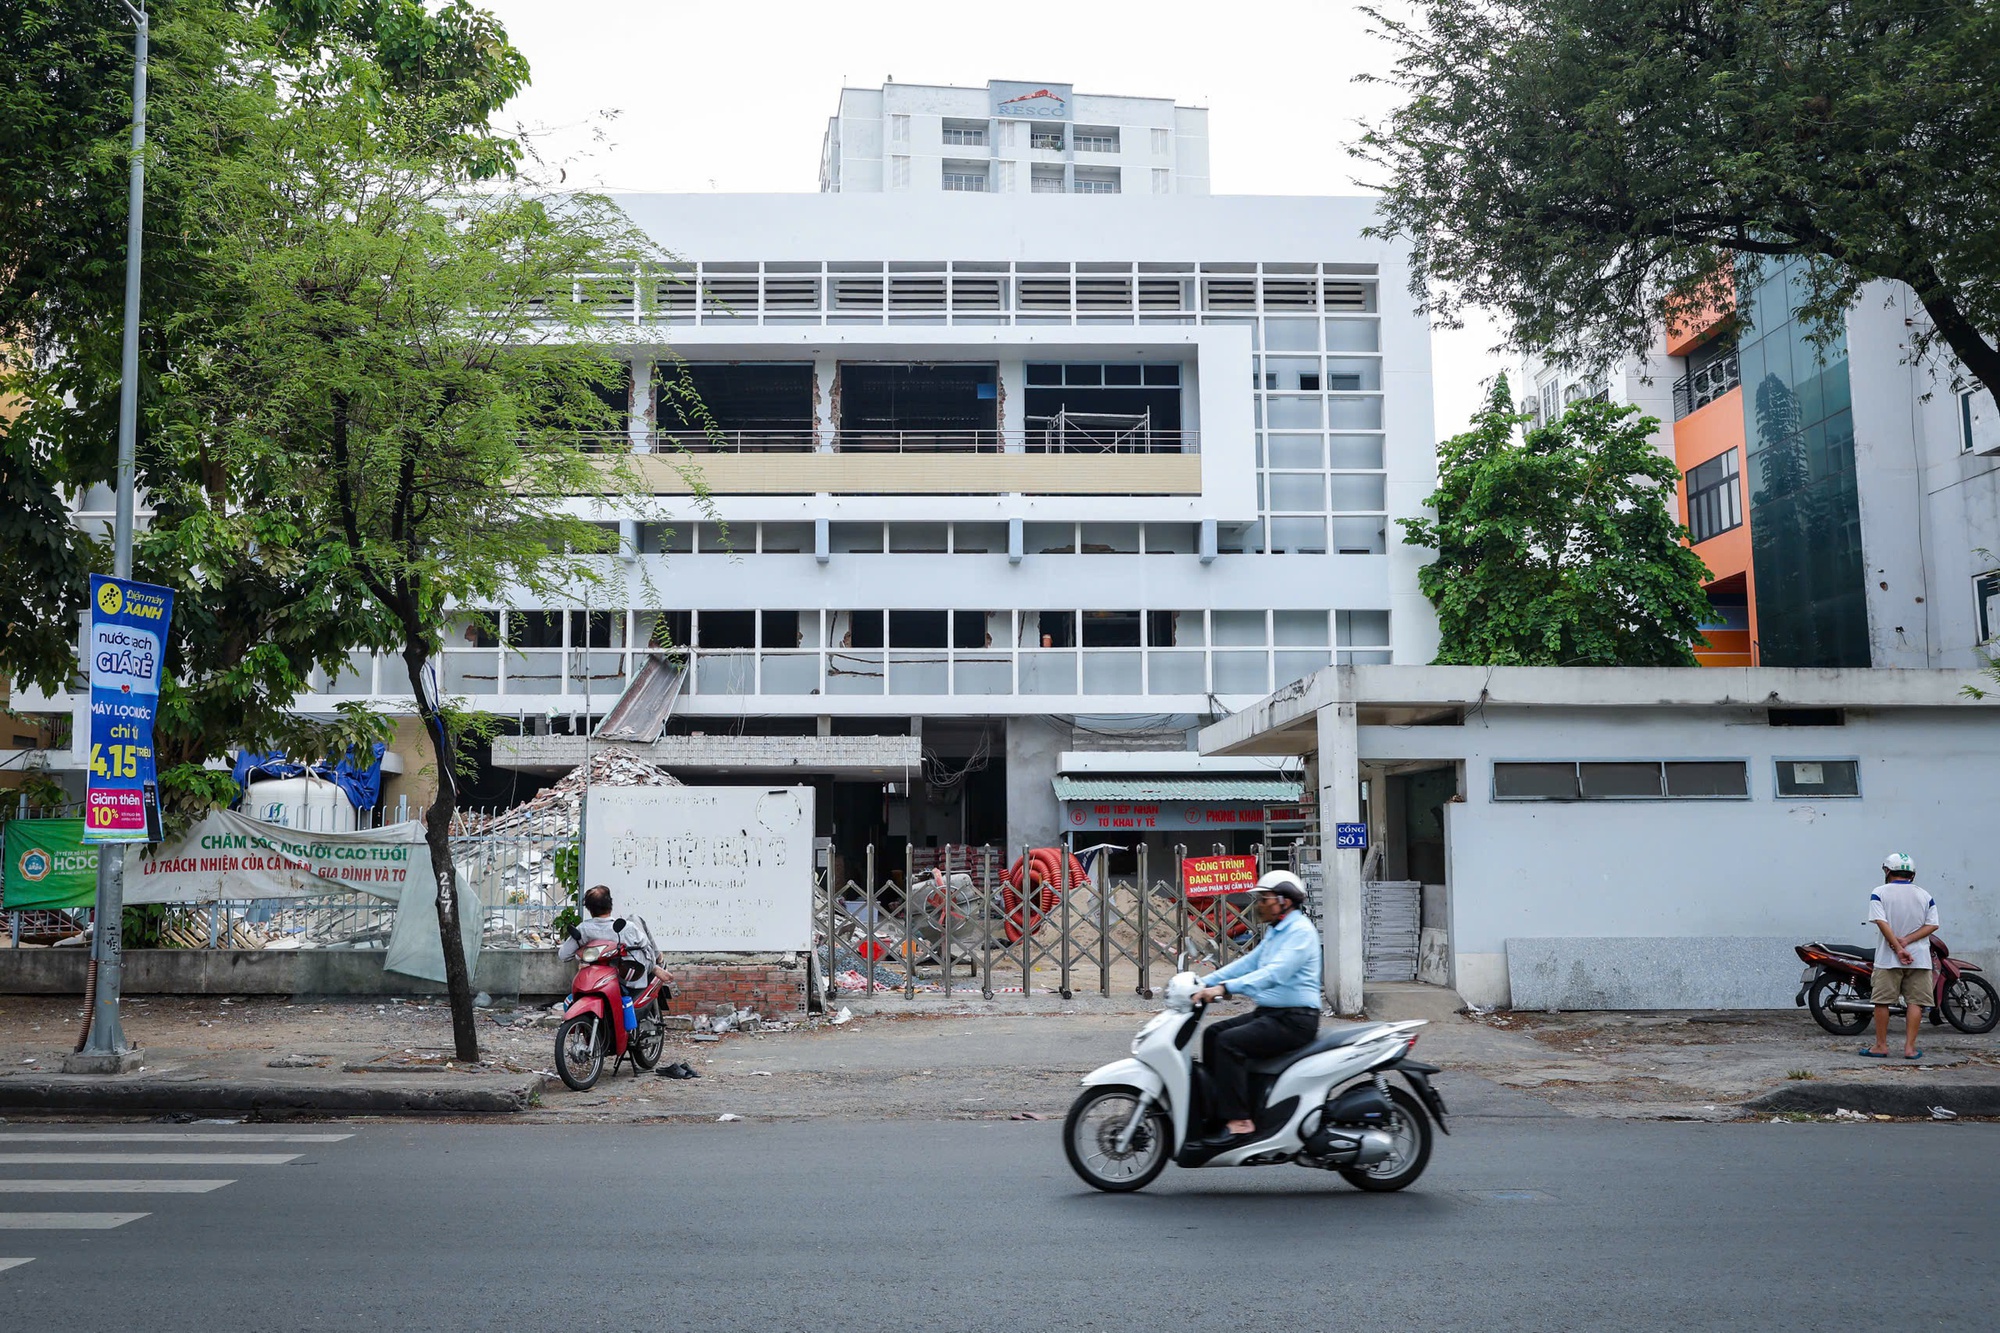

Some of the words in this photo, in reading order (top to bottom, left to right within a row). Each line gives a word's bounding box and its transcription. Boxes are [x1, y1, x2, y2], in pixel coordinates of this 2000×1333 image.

[998, 105, 1065, 116] RESCO
[144, 595, 164, 607] máy
[123, 601, 163, 620] XANH
[99, 632, 130, 646] nước
[131, 637, 152, 650] ạch
[96, 650, 132, 676] GIÁ
[132, 652, 154, 679] RẺ
[91, 701, 113, 715] MÁY
[110, 723, 130, 738] chỉ
[90, 743, 137, 780] 4,15
[90, 792, 118, 805] Giảm
[92, 806, 119, 826] 10%
[1113, 818, 1134, 827] KHAI
[1136, 818, 1142, 827] Y
[1338, 824, 1364, 833] CỔNG
[201, 832, 247, 849] CHĂM
[280, 842, 331, 859] NGƯỜI
[334, 847, 367, 860] CAO
[369, 843, 407, 861] TUỔI
[1338, 833, 1355, 845] SỐ
[1357, 836, 1365, 845] 1
[53, 855, 99, 871] HCDC
[143, 859, 157, 875] LÀ
[159, 855, 197, 873] TRÁCH
[200, 854, 238, 875] NHIỆM
[241, 853, 264, 870] CỦA
[266, 854, 281, 870] CÁ
[318, 866, 338, 879] GIA
[341, 865, 372, 881] ĐÌNH
[374, 866, 389, 881] VÀ
[1195, 860, 1218, 872] CÔNG
[1220, 858, 1245, 869] TRÌNH
[1189, 874, 1213, 884] ĐANG
[1214, 872, 1228, 882] THI
[1230, 869, 1253, 881] CÔNG
[440, 871, 453, 913] 247
